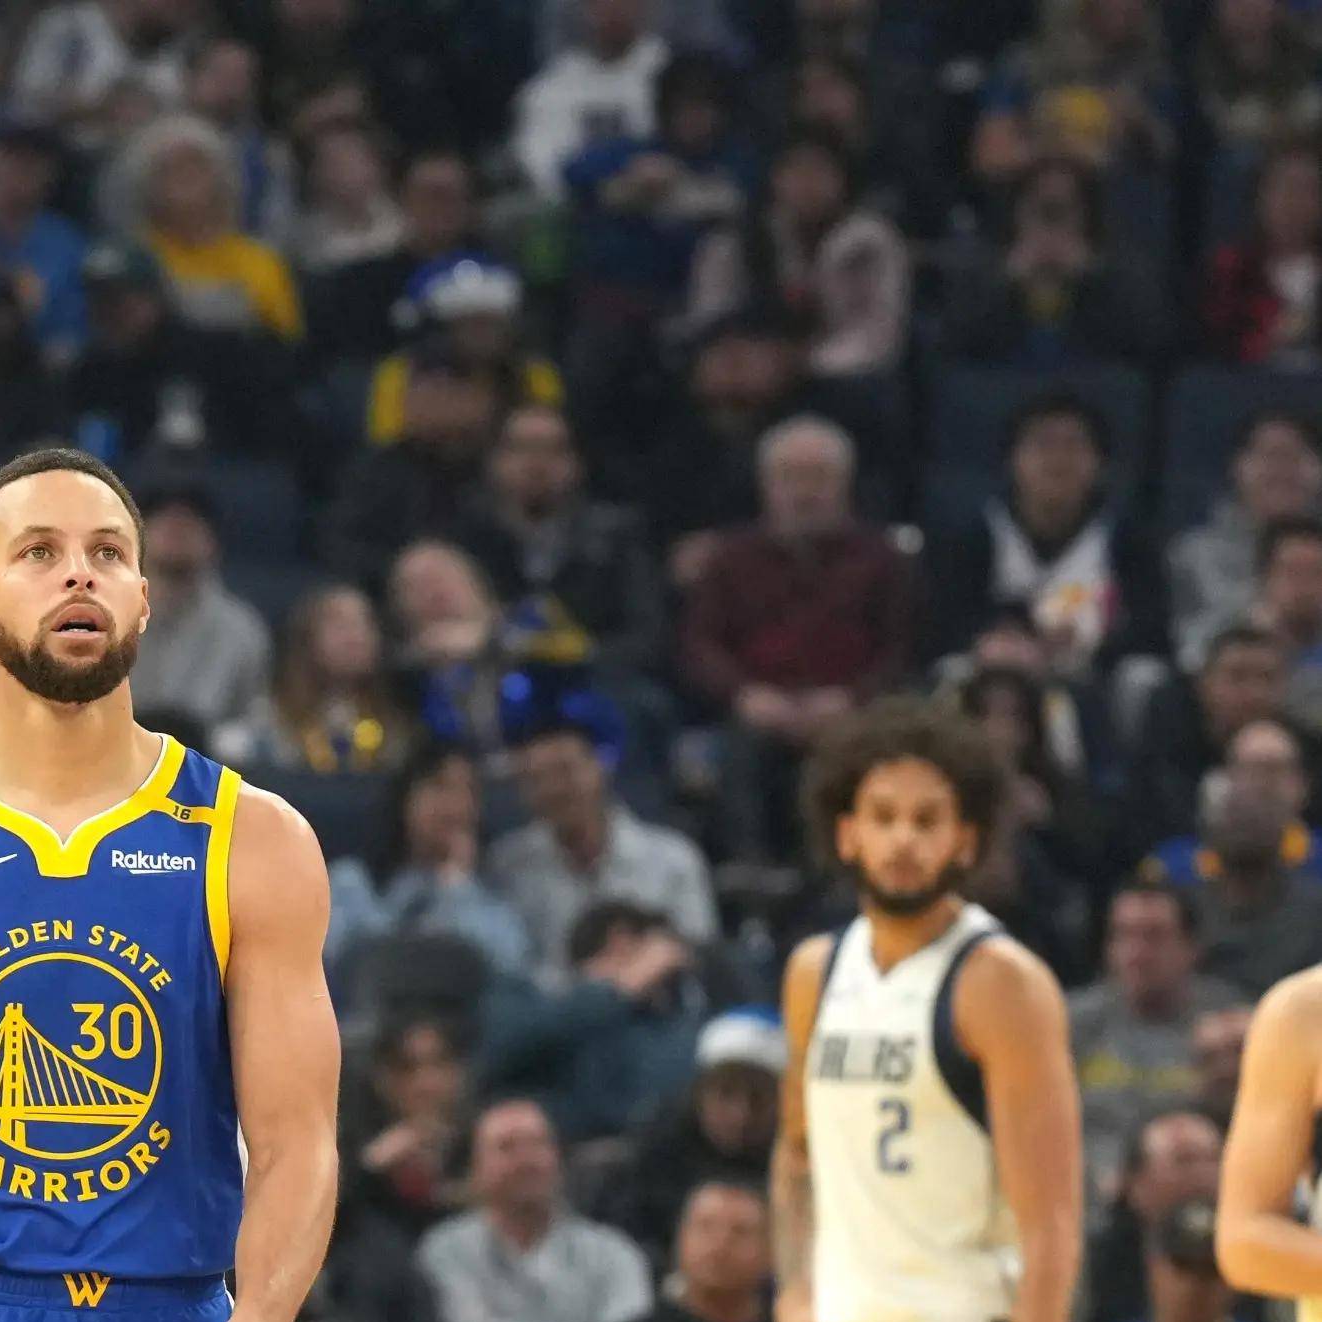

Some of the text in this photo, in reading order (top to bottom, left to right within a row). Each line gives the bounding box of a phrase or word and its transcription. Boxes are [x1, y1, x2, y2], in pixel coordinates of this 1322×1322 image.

[111, 849, 196, 872] Rakuten
[88, 925, 173, 993] STATE
[70, 1003, 142, 1060] 30
[878, 1098, 914, 1175] 2
